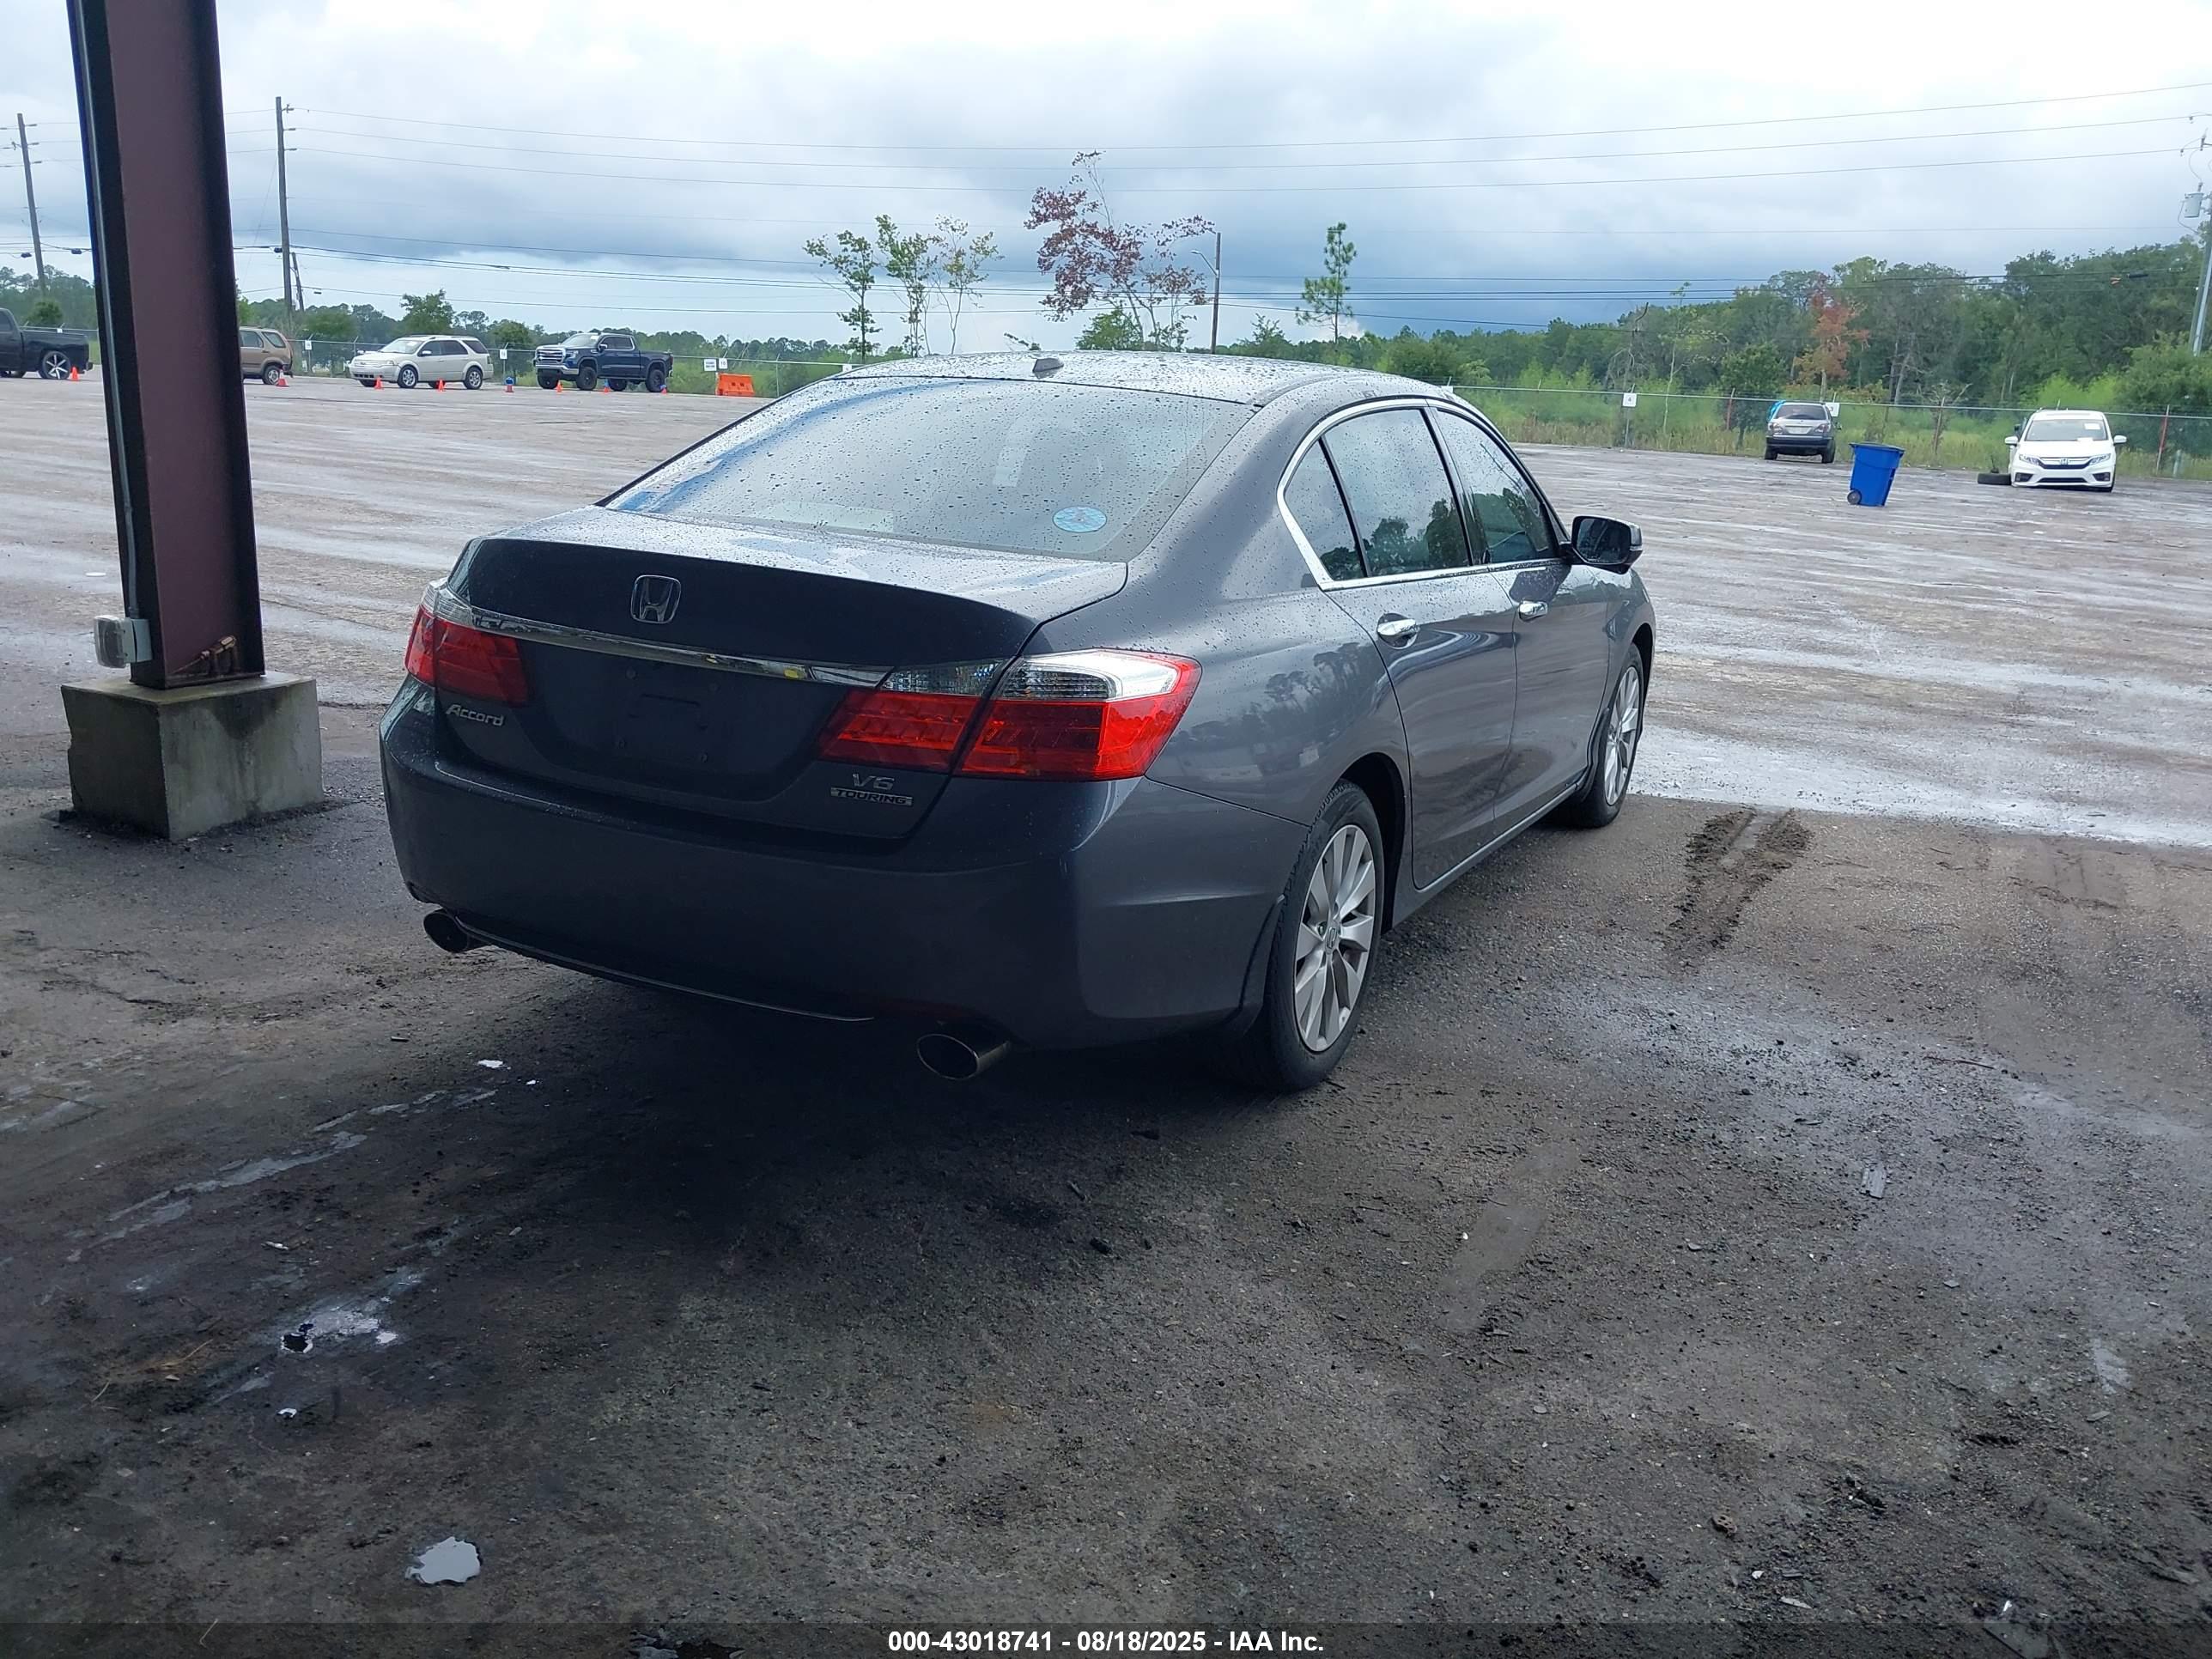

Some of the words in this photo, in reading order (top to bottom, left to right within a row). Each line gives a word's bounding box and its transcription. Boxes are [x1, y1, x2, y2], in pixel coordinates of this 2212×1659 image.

[446, 704, 504, 726] Accord
[852, 773, 895, 790] V6
[836, 789, 907, 805] TOURING
